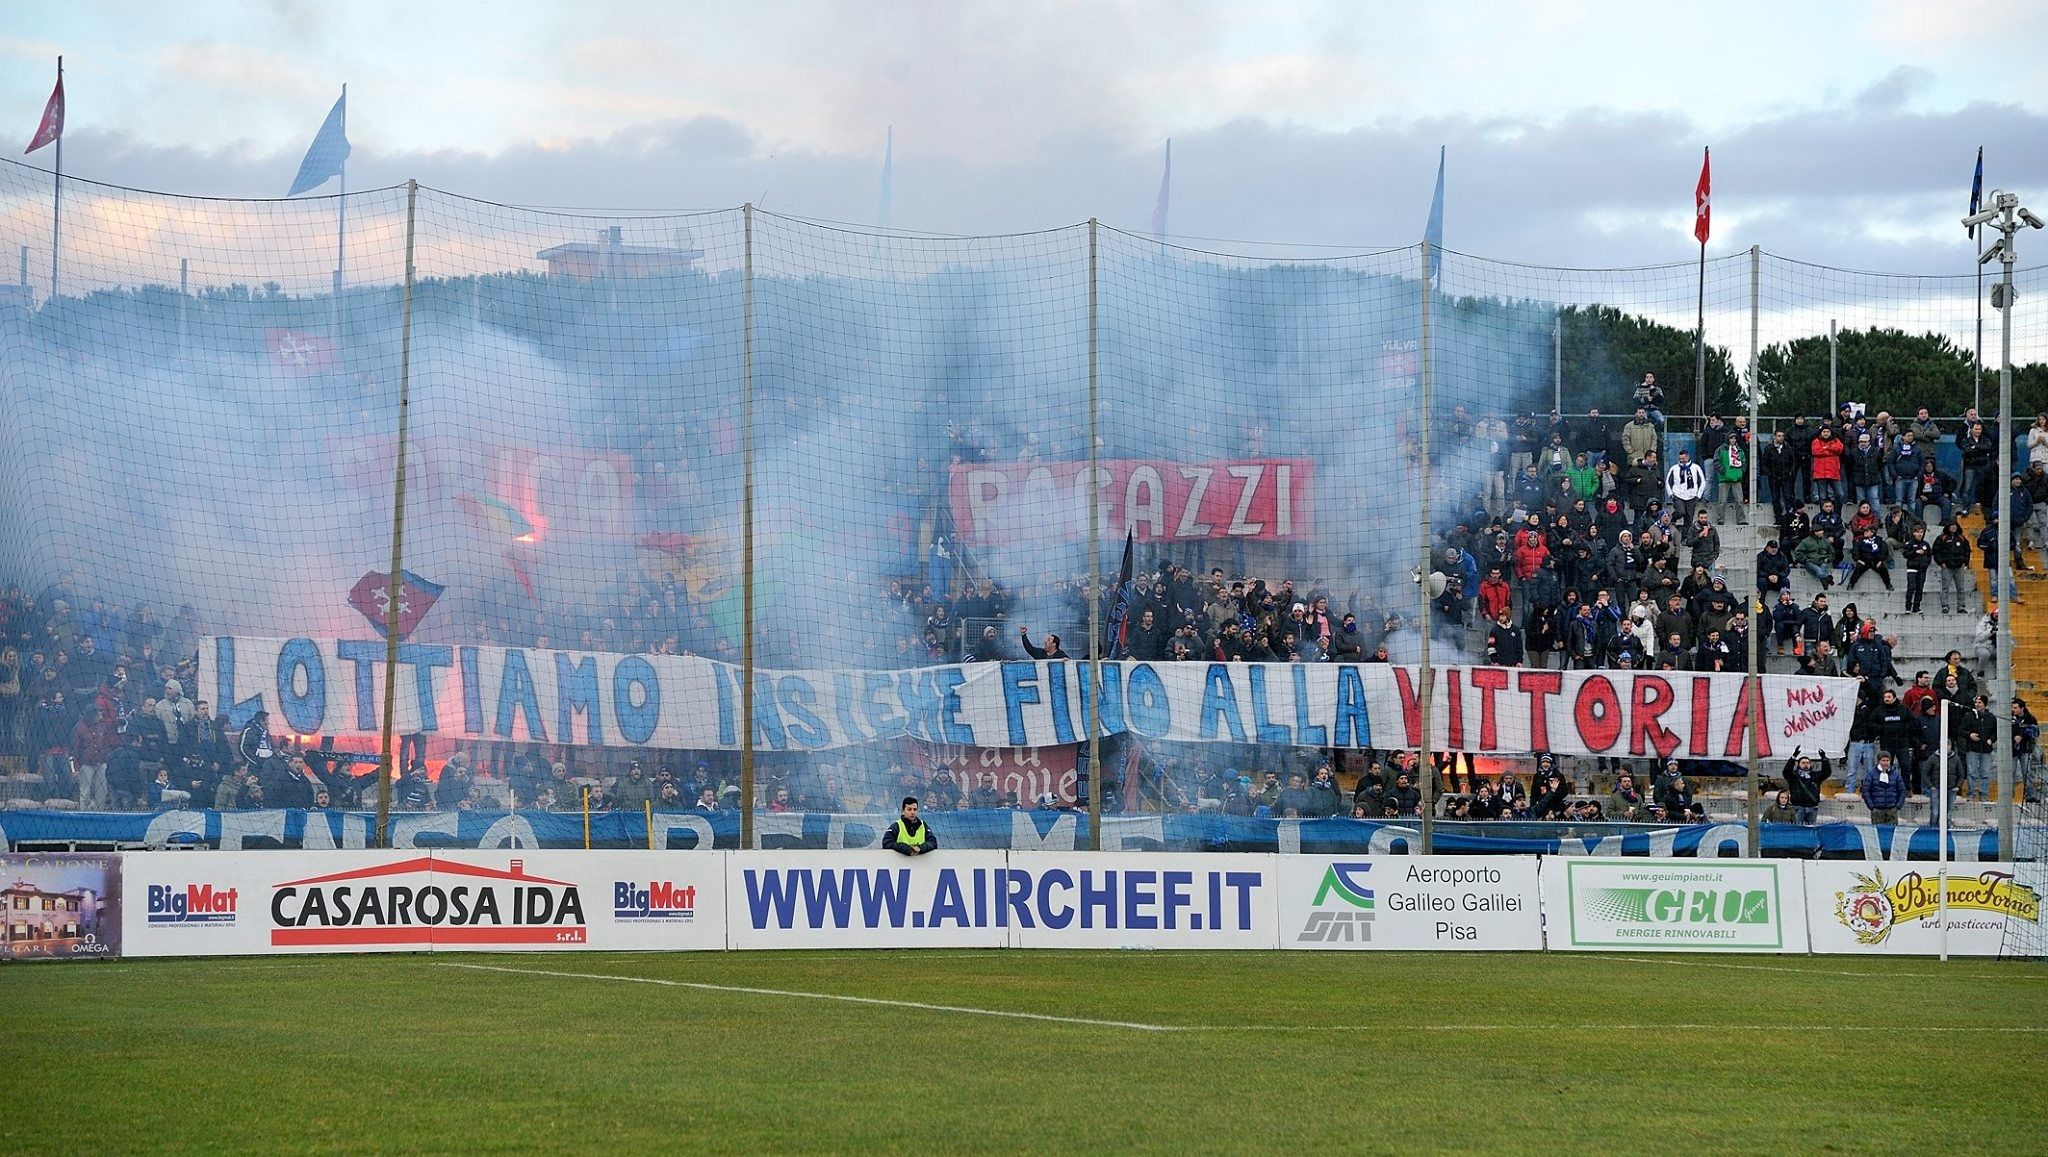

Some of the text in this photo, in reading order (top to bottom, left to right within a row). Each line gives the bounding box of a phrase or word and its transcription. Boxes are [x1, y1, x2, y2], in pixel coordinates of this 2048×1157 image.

[966, 463, 1292, 538] RAGAZZI
[216, 636, 1773, 759] LOTTIAMO INSIEME FINO ALLA VITTORIA
[1786, 685, 1824, 708] MAU
[1406, 864, 1502, 887] Aeroporto
[1622, 873, 1723, 883] www.geuimpianti.it
[148, 884, 238, 921] BigMat
[271, 885, 586, 926] CASAROSA IDA
[614, 881, 696, 918] BigMat
[743, 867, 1262, 931] WWW.AIRCHEF.IT
[1388, 893, 1523, 912] Galileo Galilei
[1645, 888, 1747, 924] GEU
[1298, 911, 1376, 942] SAT
[1436, 921, 1478, 941] Pisa
[1616, 928, 1737, 939] ENERGIE RINNOVABILI
[1921, 919, 1946, 930] art
[71, 943, 110, 953] OMEGA
[556, 931, 583, 942] s.r.l.
[0, 945, 48, 953] LGARI
